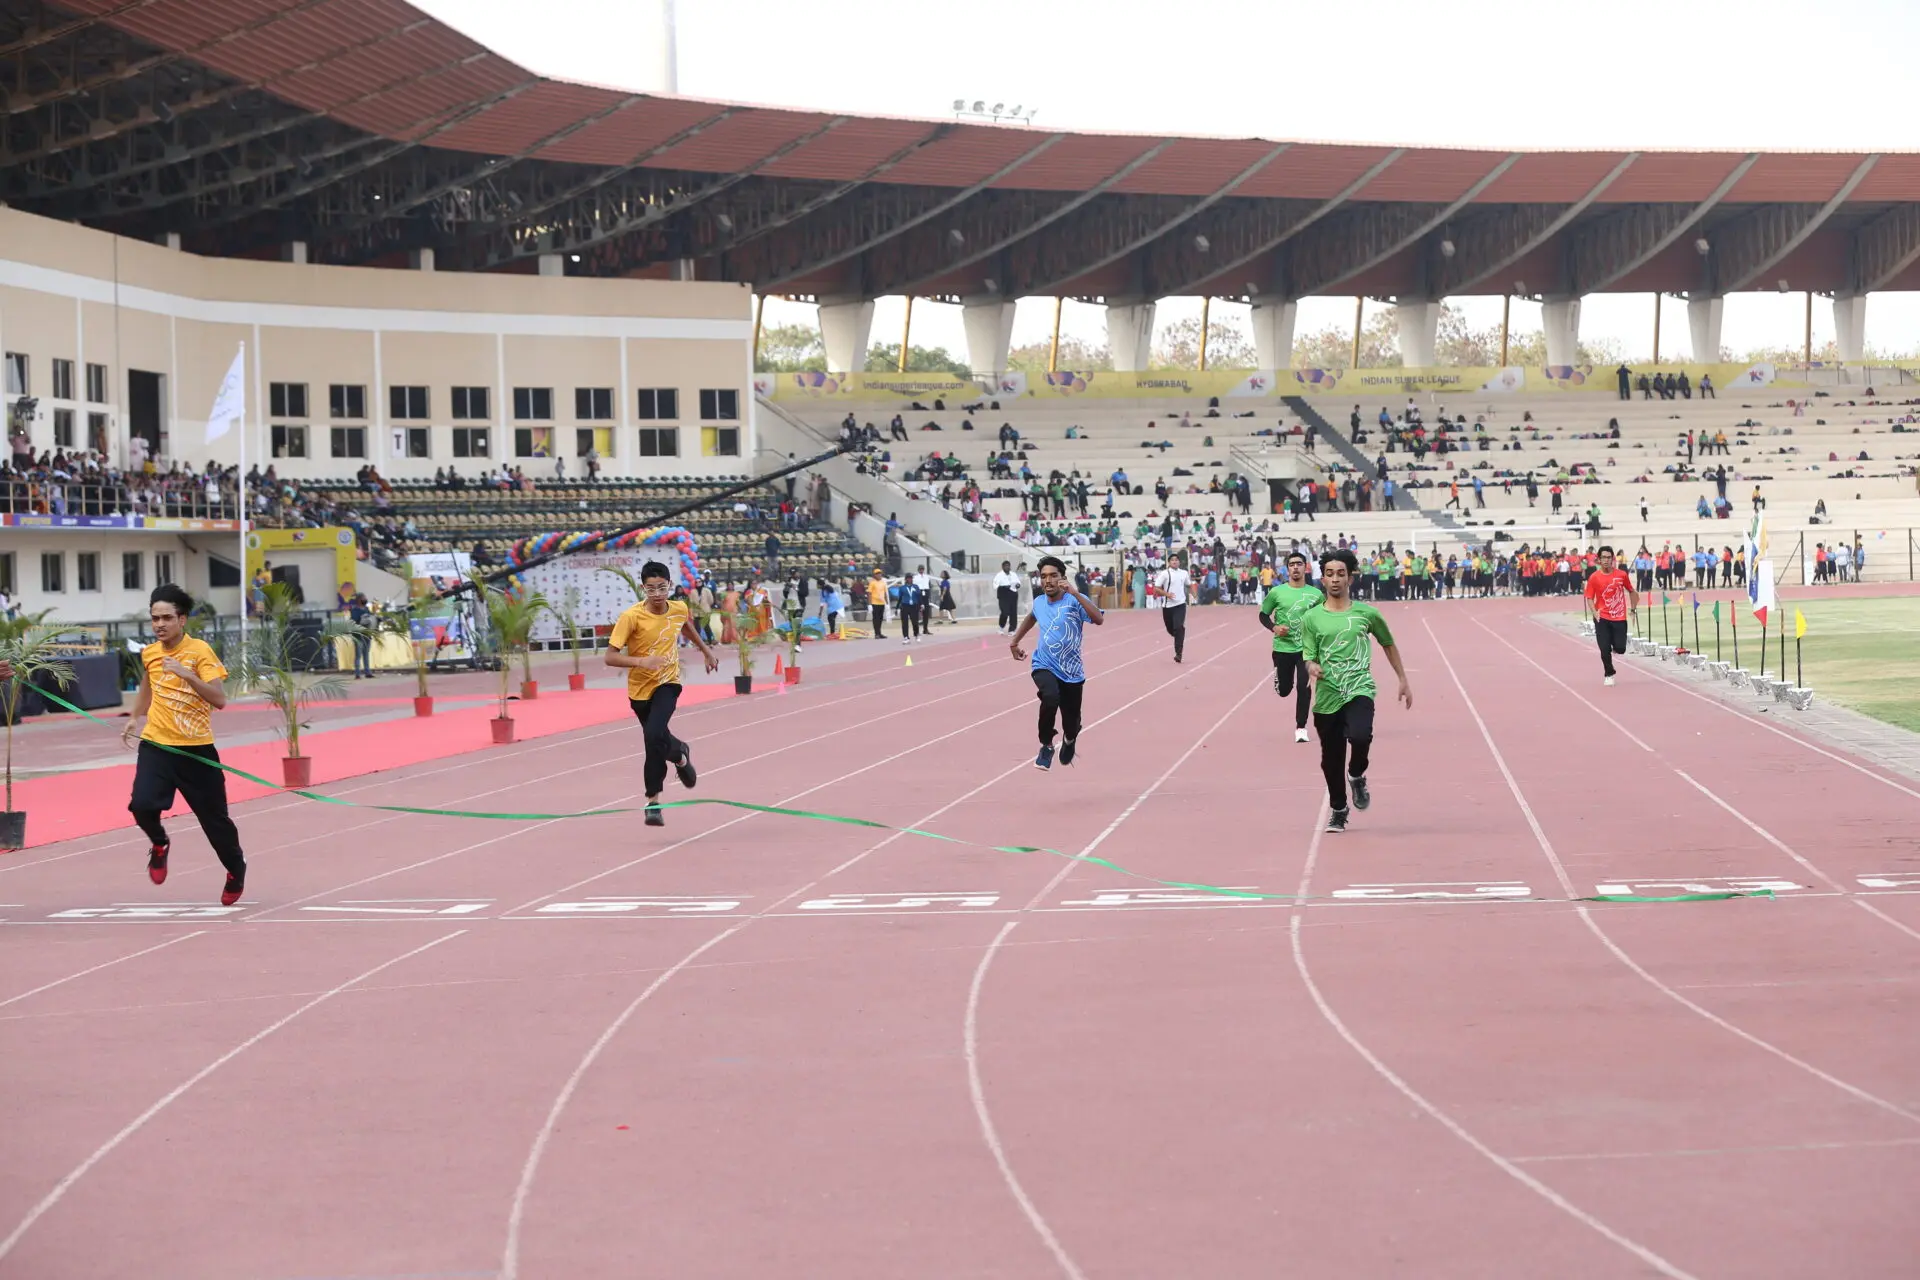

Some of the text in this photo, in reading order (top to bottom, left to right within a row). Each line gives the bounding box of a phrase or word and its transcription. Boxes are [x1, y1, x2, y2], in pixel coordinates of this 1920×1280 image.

[1361, 376, 1392, 386] INDIAN
[1427, 375, 1460, 385] LEAGUE
[797, 896, 1000, 909] 5
